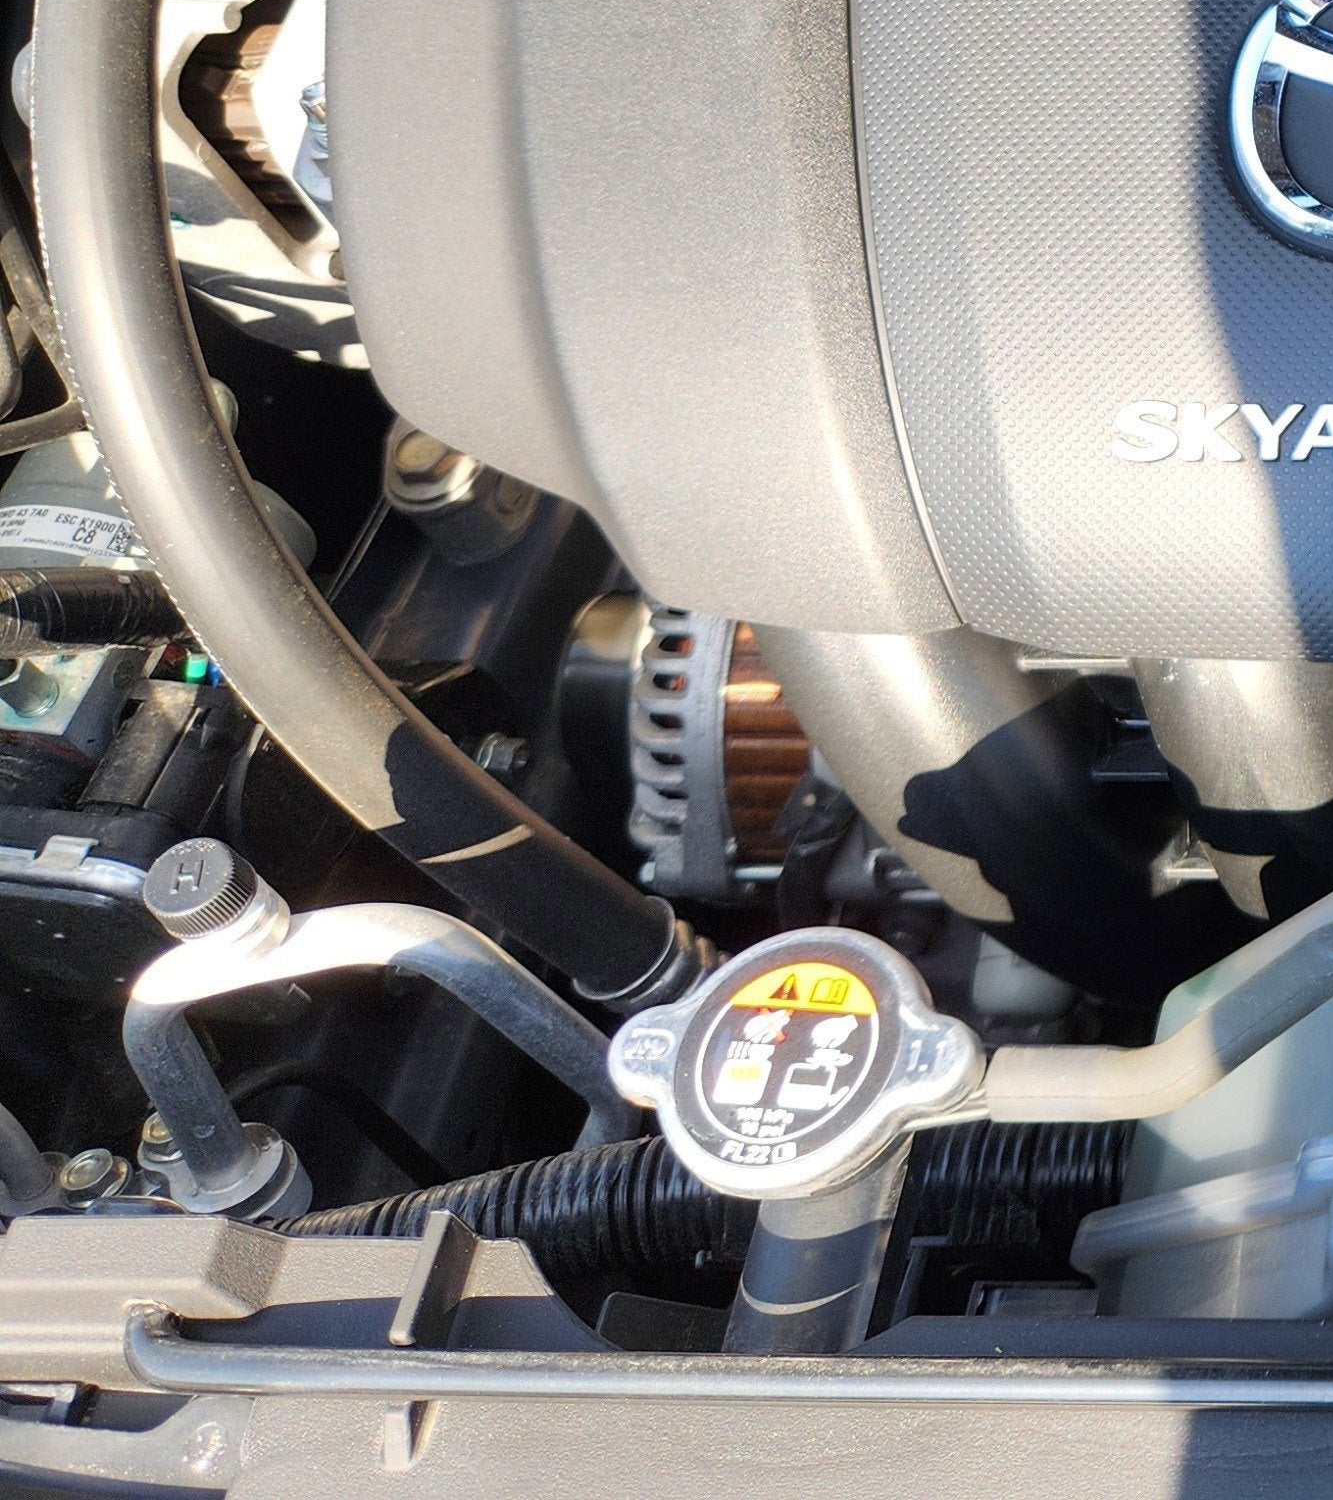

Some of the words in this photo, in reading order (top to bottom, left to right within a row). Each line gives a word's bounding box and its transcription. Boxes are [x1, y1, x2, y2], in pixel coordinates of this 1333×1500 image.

[55, 513, 78, 525] ESC
[79, 518, 116, 533] K1900
[72, 527, 97, 544] C8
[170, 859, 204, 894] H
